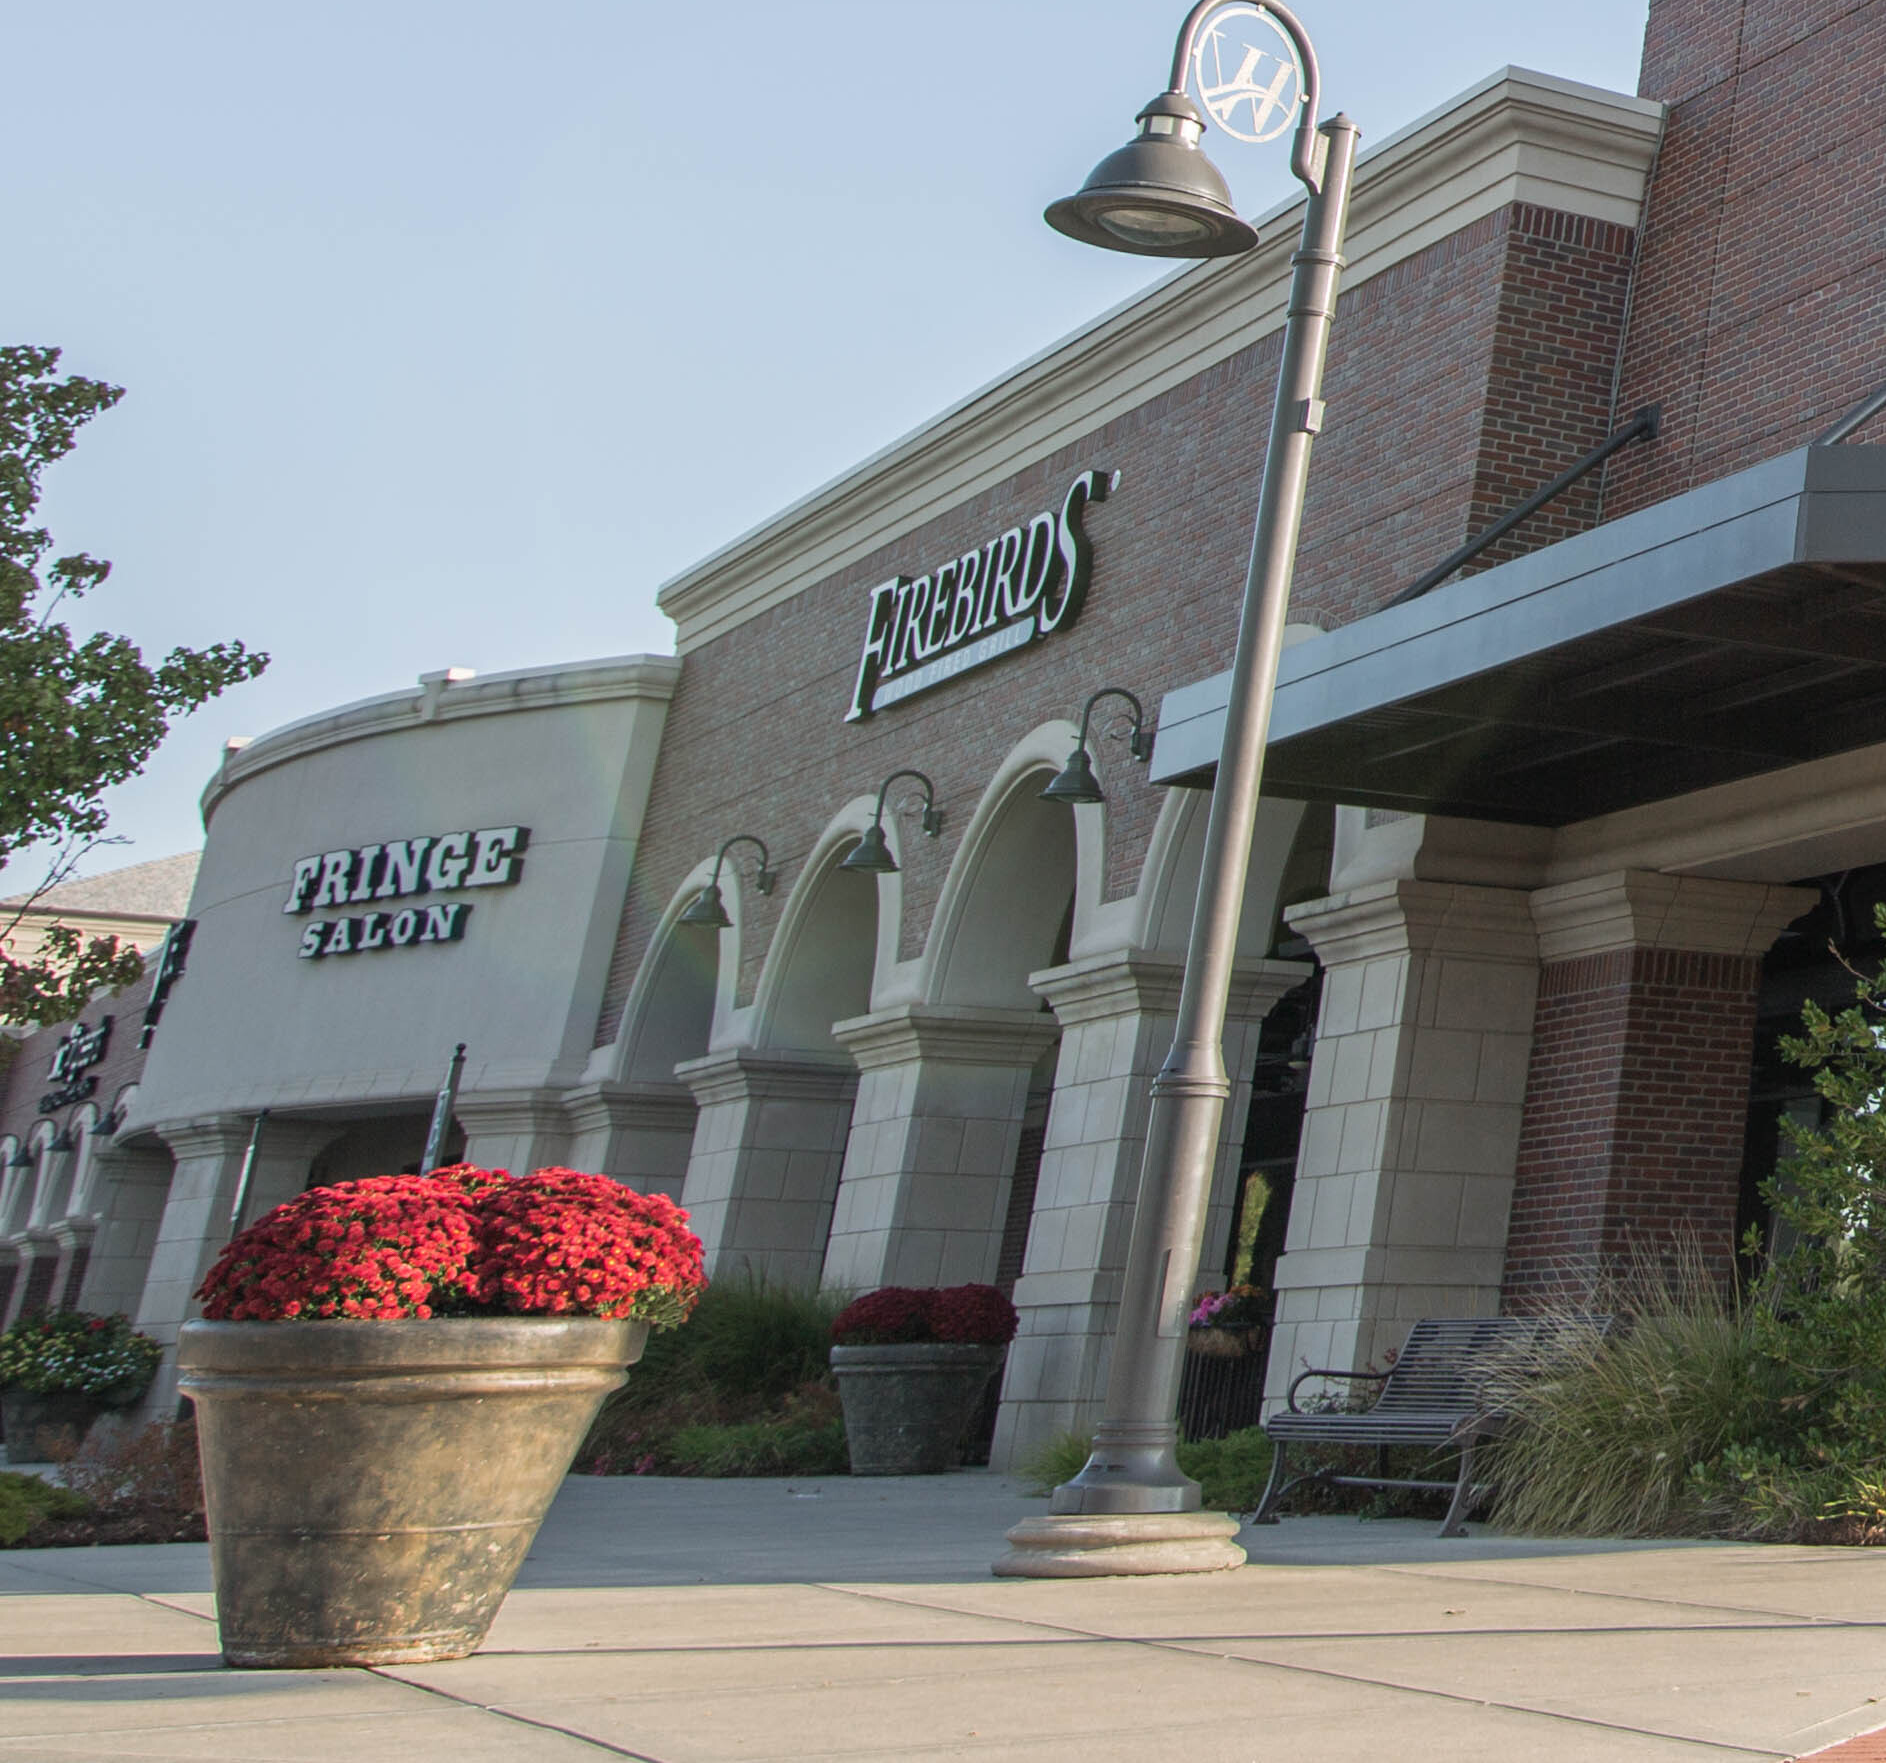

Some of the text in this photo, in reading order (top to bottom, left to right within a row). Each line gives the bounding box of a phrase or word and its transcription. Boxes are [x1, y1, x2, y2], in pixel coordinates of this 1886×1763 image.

[844, 470, 1108, 723] FIREBIRDS
[283, 825, 528, 914] FRINGE
[297, 903, 472, 958] SALON
